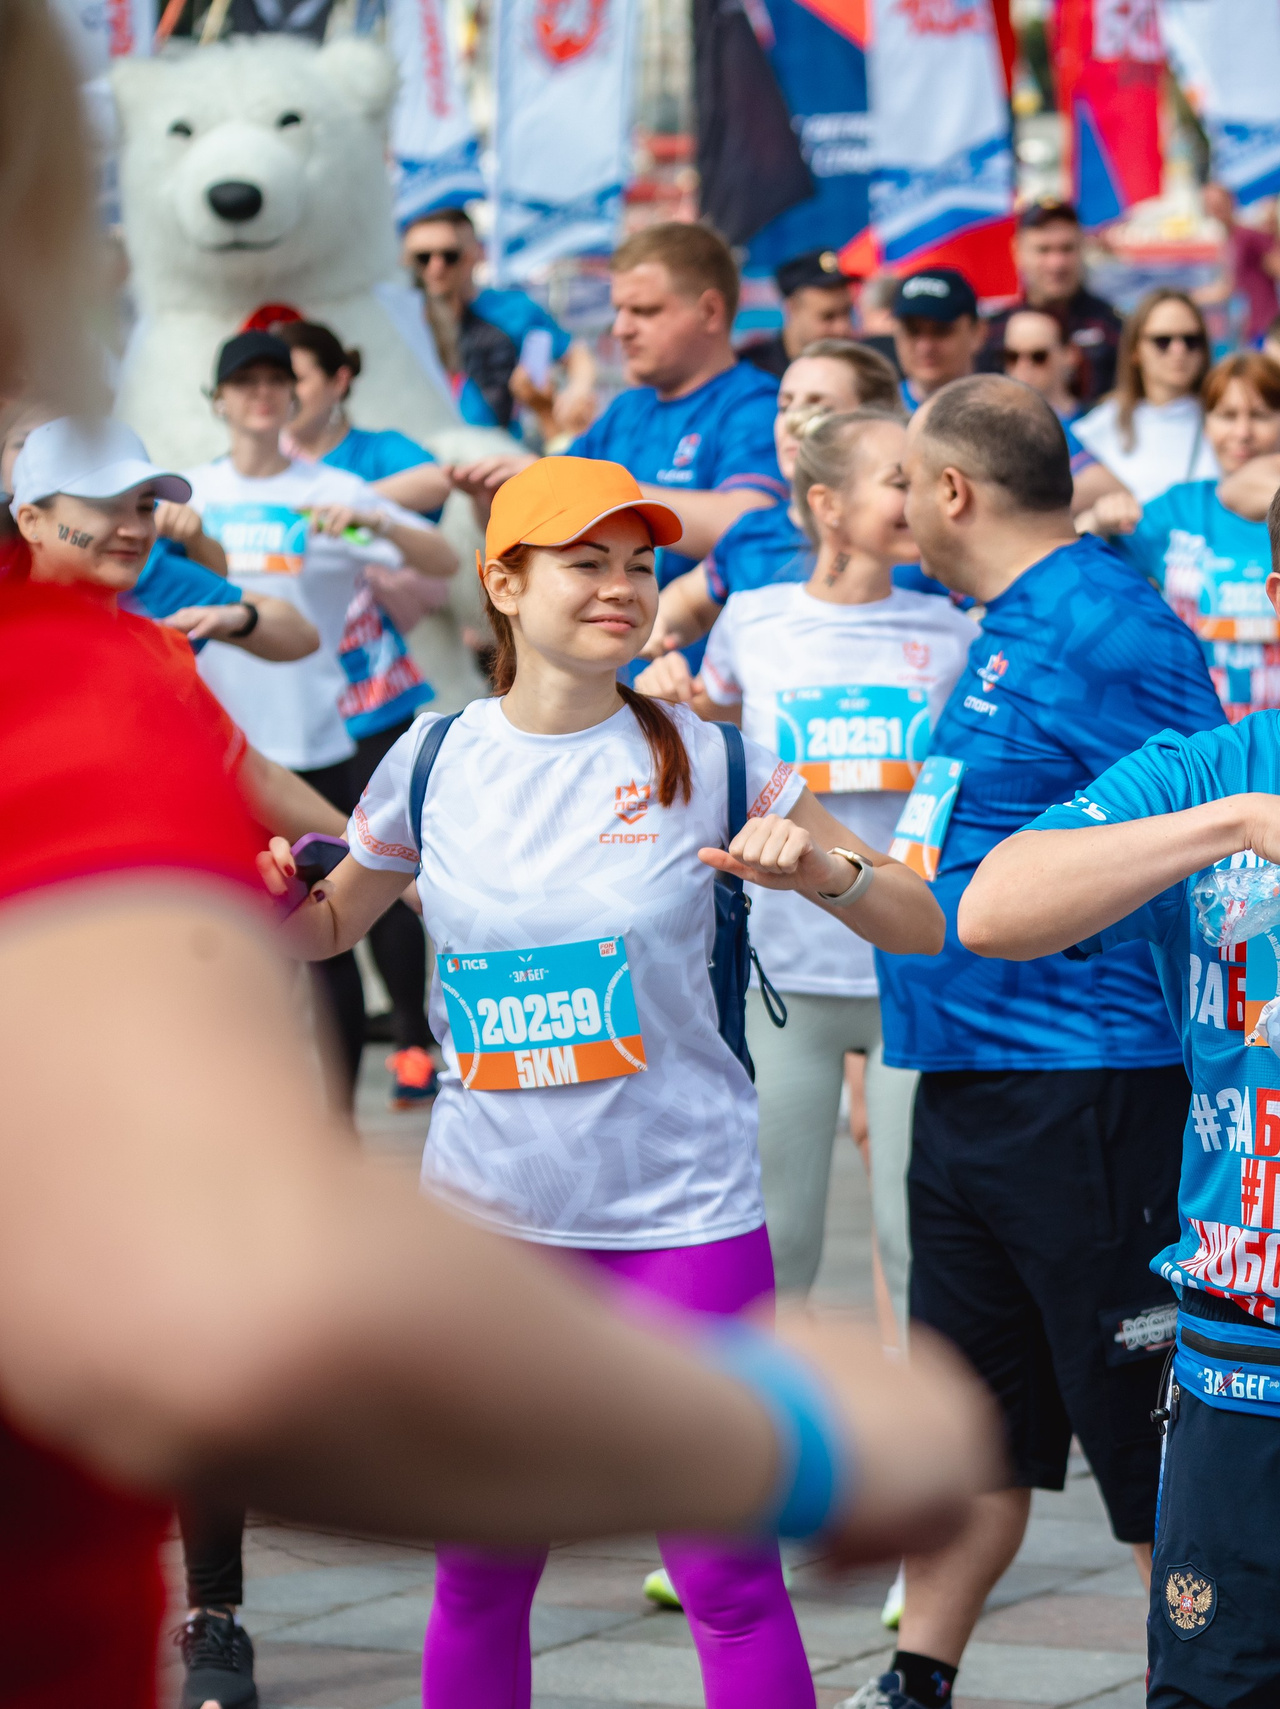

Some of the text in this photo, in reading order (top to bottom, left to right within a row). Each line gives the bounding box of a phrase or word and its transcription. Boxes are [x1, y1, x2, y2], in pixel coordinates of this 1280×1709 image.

[963, 694, 998, 717] СПОРТ
[807, 716, 903, 757] 20251
[599, 833, 659, 844] СПОРТ
[462, 959, 488, 970] ПСБ
[477, 987, 602, 1046] 20259
